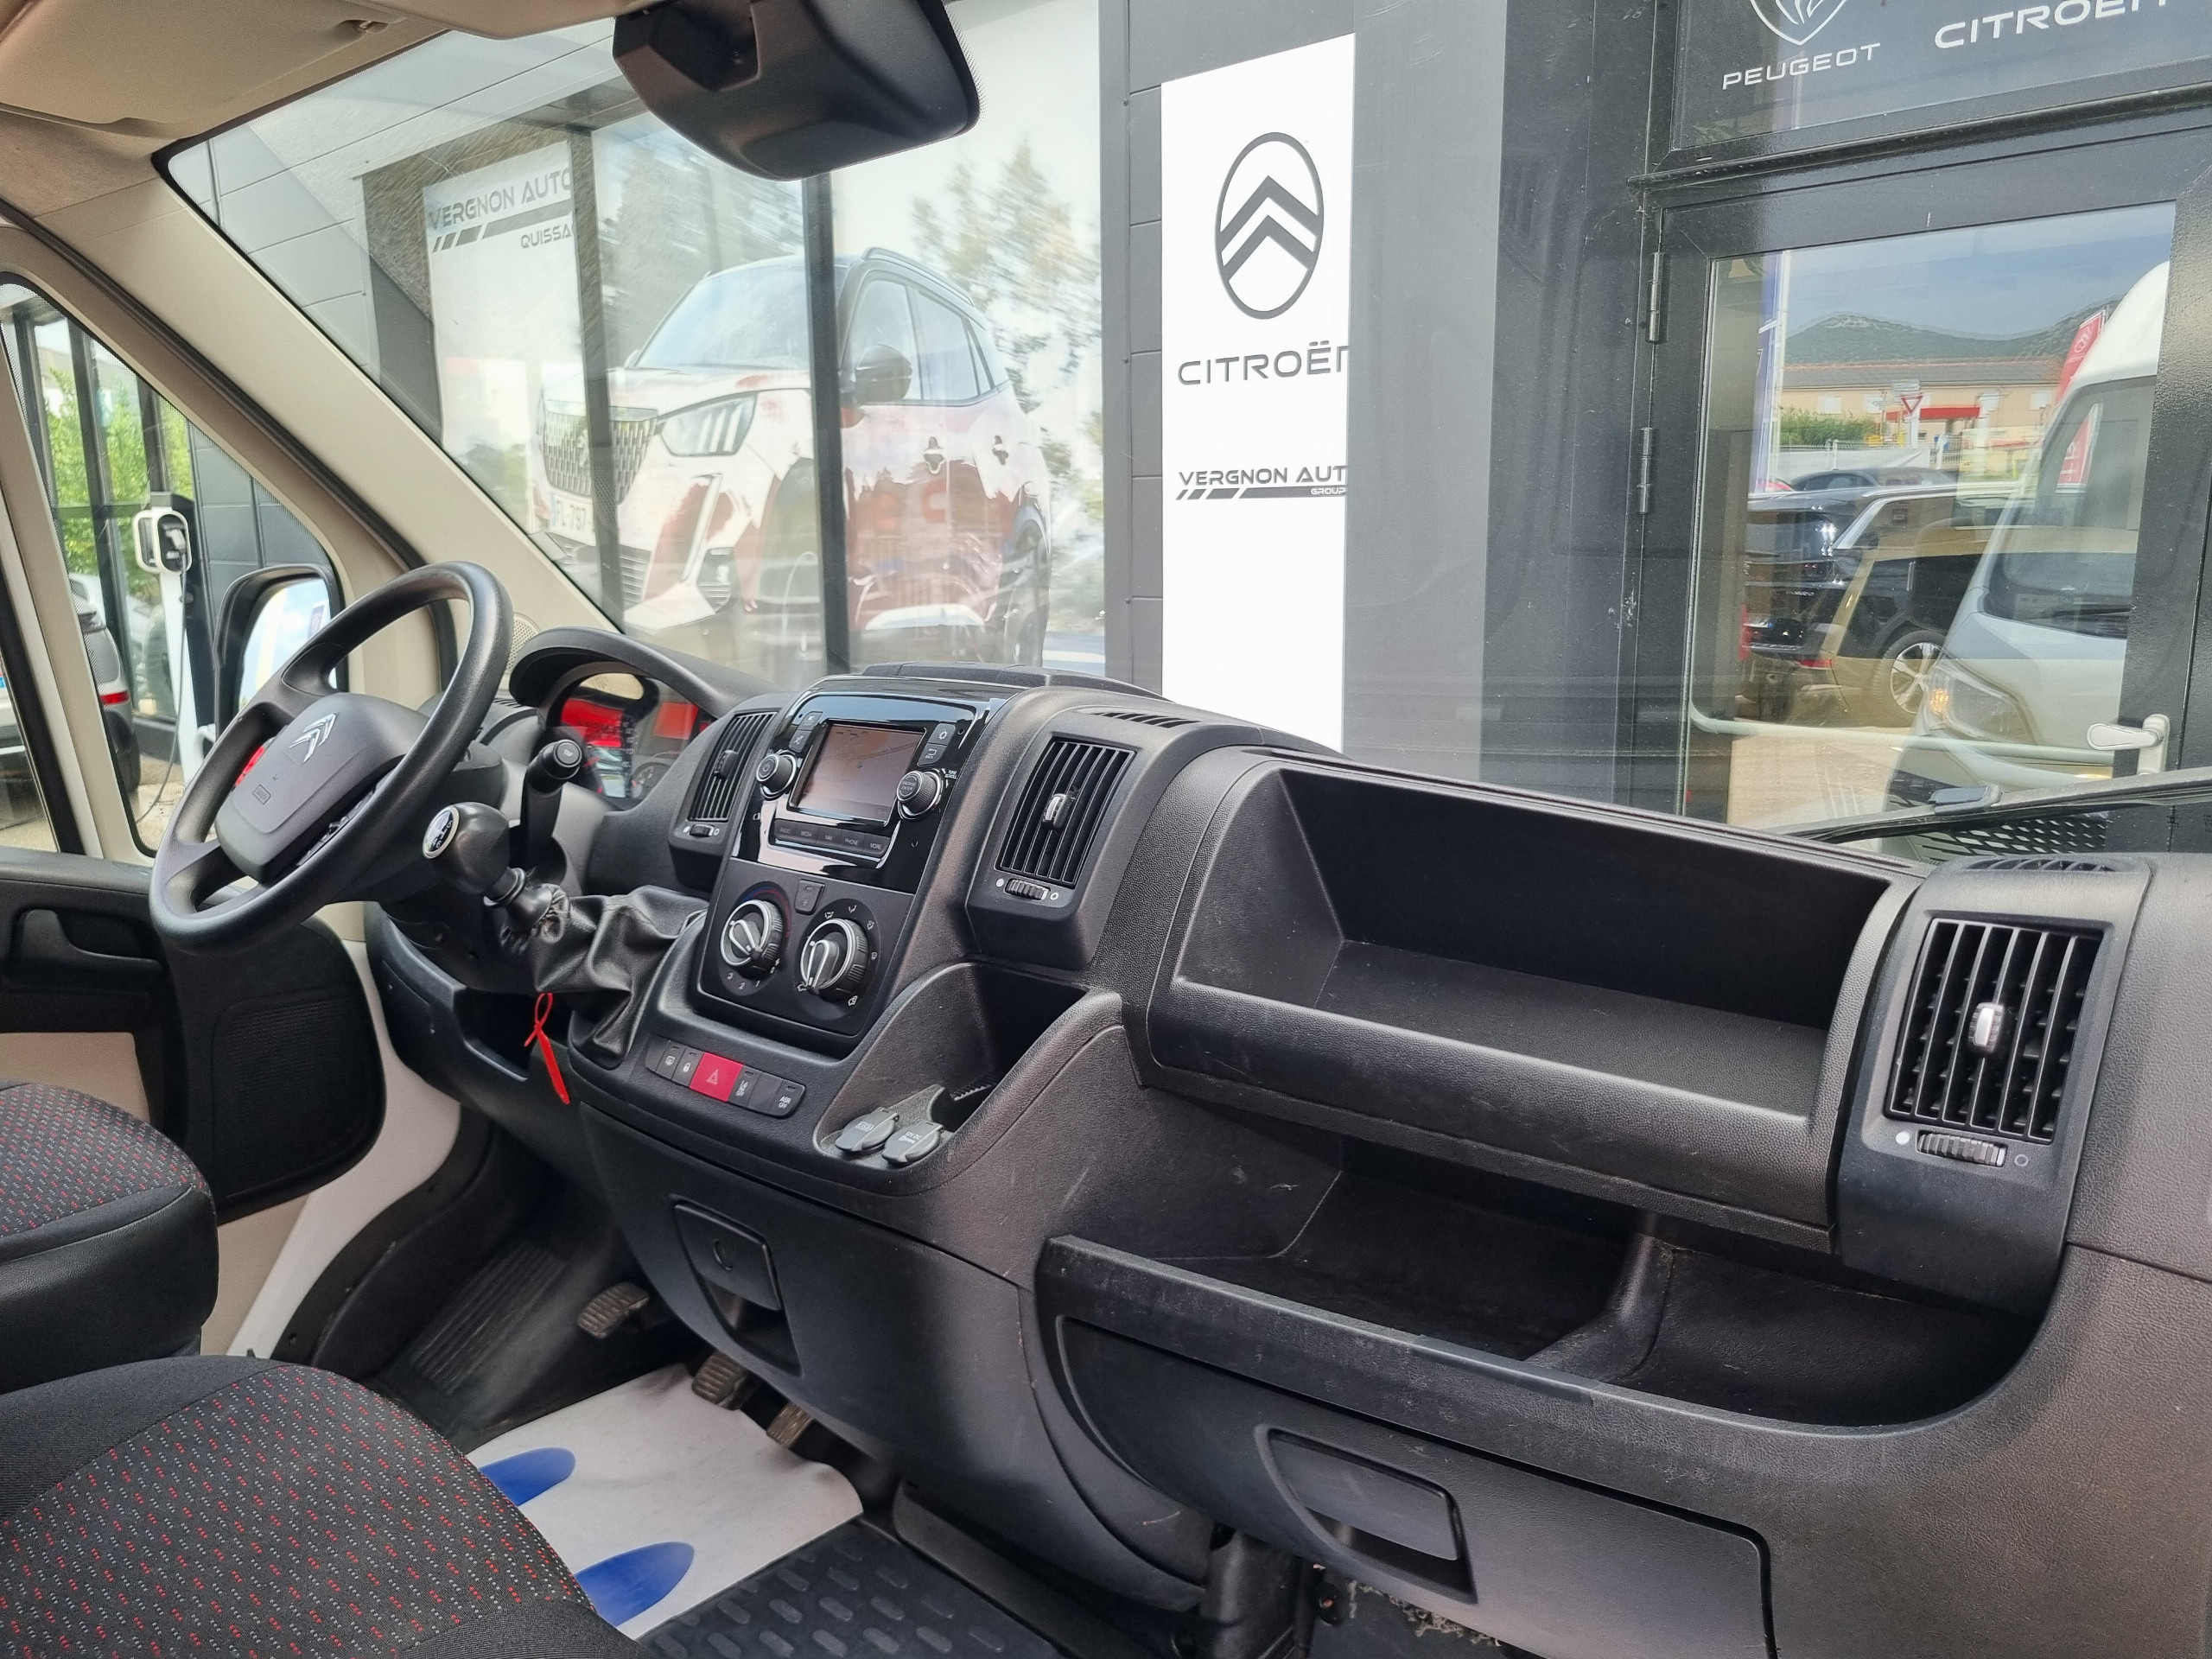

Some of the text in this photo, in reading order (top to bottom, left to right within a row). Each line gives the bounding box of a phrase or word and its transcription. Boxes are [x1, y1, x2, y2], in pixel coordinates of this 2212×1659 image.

[1722, 42, 1881, 90] PEUGEOT
[429, 186, 516, 230] VERGNON
[1179, 467, 1287, 486] VERGNON
[728, 971, 734, 981] 3
[739, 982, 746, 990] 2
